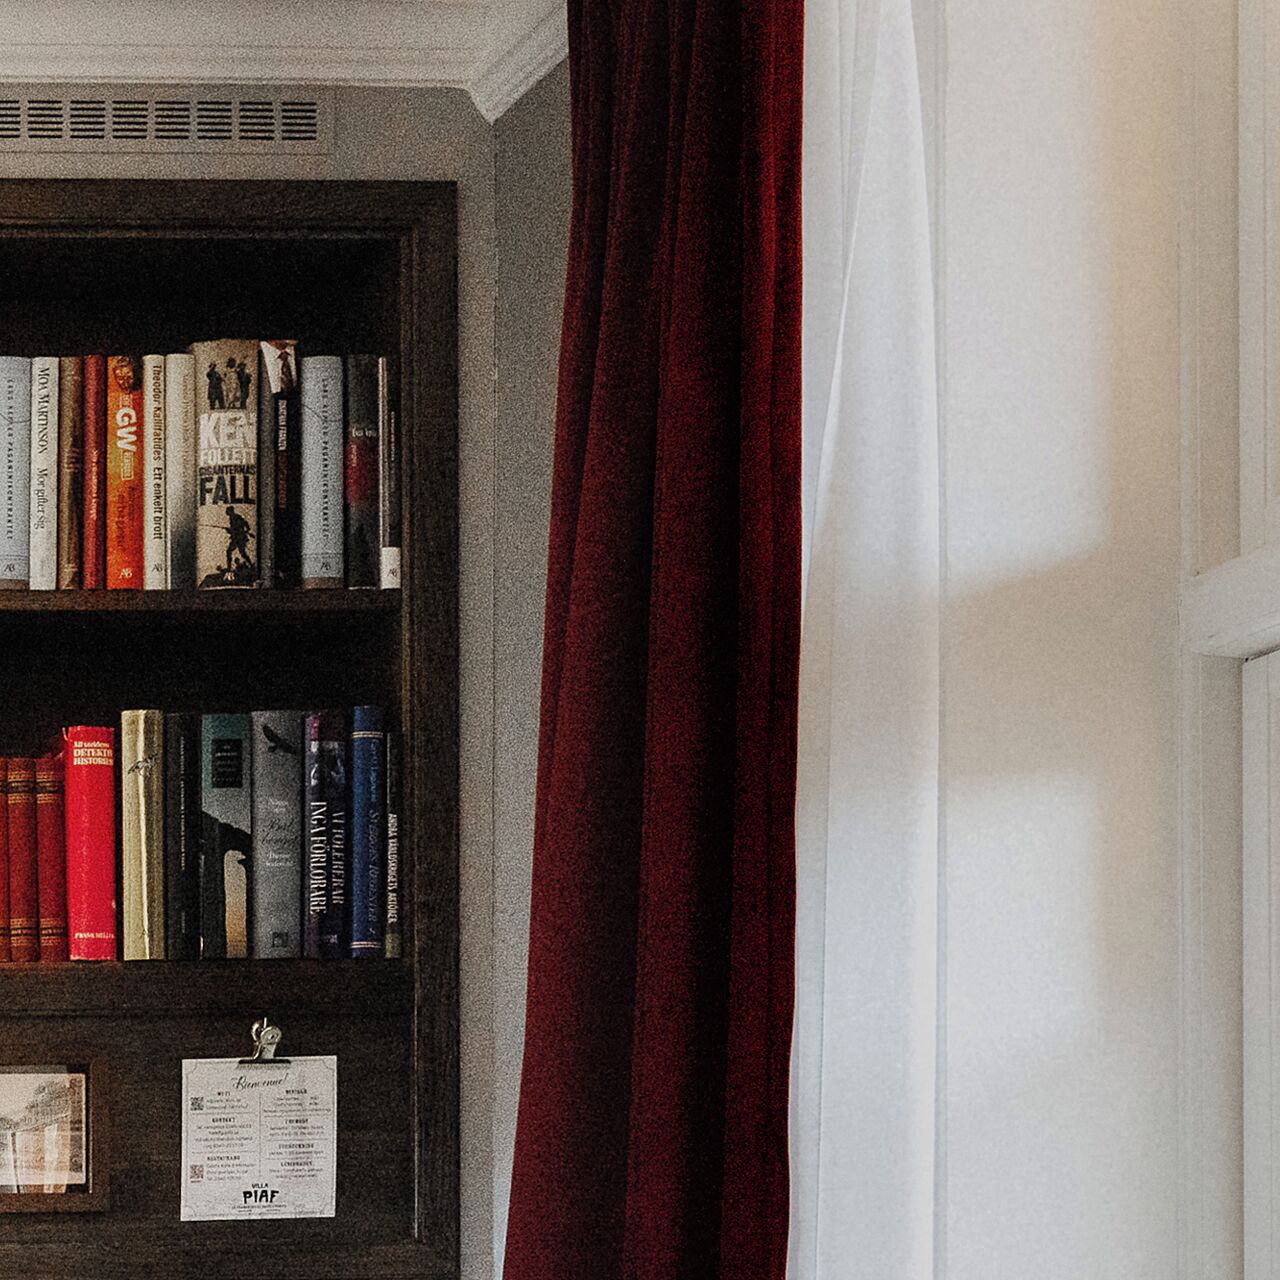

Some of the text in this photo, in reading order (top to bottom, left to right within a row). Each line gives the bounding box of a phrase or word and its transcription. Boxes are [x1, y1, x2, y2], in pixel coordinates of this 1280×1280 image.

[37, 367, 50, 454] MOA MARTINSON
[116, 407, 137, 452] GW
[153, 364, 163, 461] Theodor Kallifatides
[199, 411, 257, 448] KEN
[200, 448, 257, 466] FOLLETT
[34, 468, 48, 530] Mor gifter sig
[152, 466, 163, 540] Ett enkelt brott
[200, 476, 256, 506] FALL
[310, 801, 330, 915] INGA FÖRLORARE
[332, 811, 344, 904] VI TOLERERAR
[242, 1190, 280, 1204] PIAF
